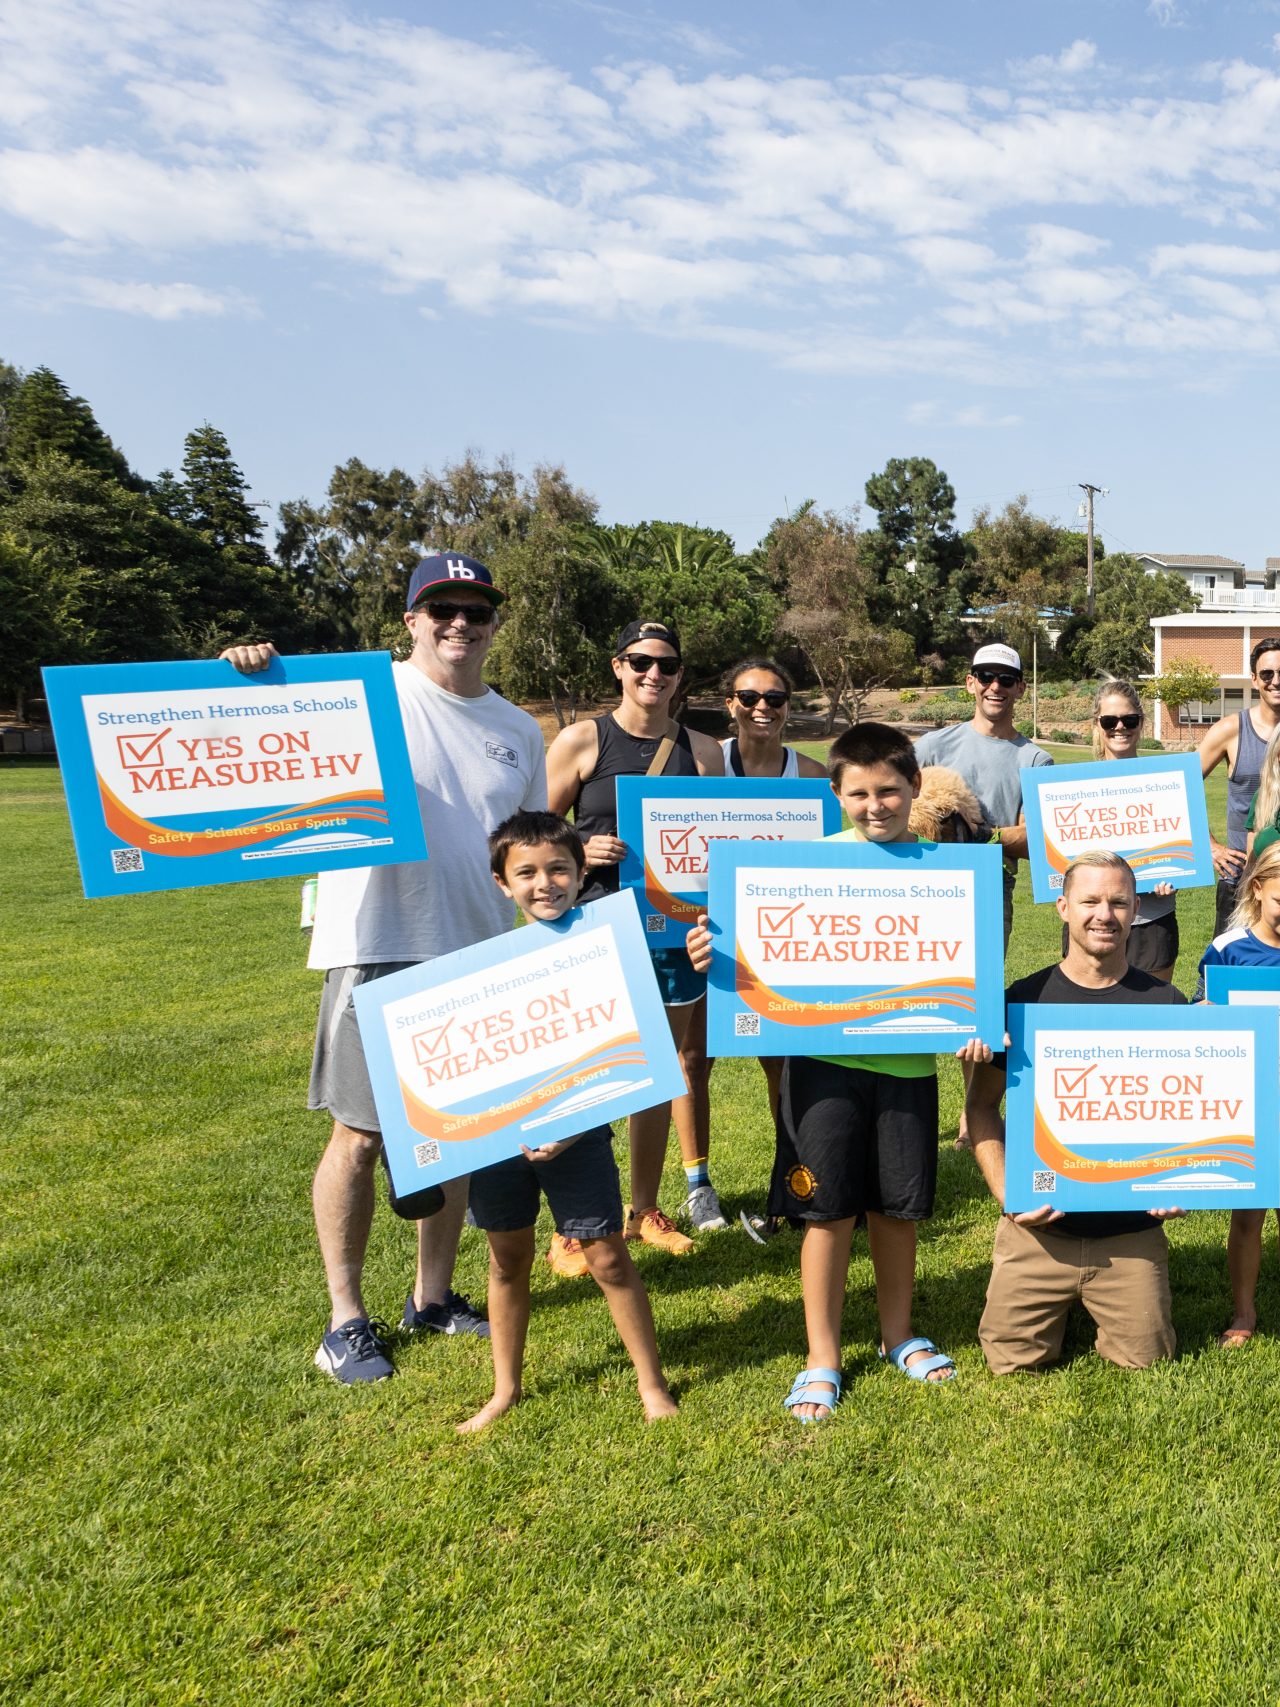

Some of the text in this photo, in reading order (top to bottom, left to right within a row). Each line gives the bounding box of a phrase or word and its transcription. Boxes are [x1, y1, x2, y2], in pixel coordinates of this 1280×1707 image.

[98, 697, 358, 726] Strengthen Hermosa Schools
[177, 731, 310, 761] YES ON
[129, 753, 363, 794] MEASURE HV
[1045, 781, 1180, 802] Strengthen Hermosa Schools
[650, 811, 817, 824] Strengthen Hermosa Schools
[1084, 803, 1154, 823] YES ON
[148, 815, 347, 846] Safety Science Solar Sports
[1059, 817, 1181, 842] MEASURE HV
[746, 884, 966, 899] Strengthen Hermosa Schools
[671, 904, 701, 914] Safety
[807, 915, 919, 936] YES ON
[762, 941, 962, 962] MEASURE HV
[395, 943, 608, 1029] Strengthen Hermosa Schools
[461, 989, 571, 1044] YES ON
[768, 1000, 939, 1013] Safety Science Solar Sports
[423, 999, 617, 1087] MEASURE HV
[1043, 1046, 1247, 1061] Strengthen Hermosa Schools
[1099, 1075, 1204, 1096] YES ON
[442, 1114, 480, 1133] Safety
[489, 1094, 532, 1117] Science
[538, 1080, 567, 1098] Solar
[573, 1066, 610, 1087] Sports
[1058, 1100, 1243, 1122] MEASURE HV
[1063, 1157, 1221, 1170] Safety Science Solar Sports
